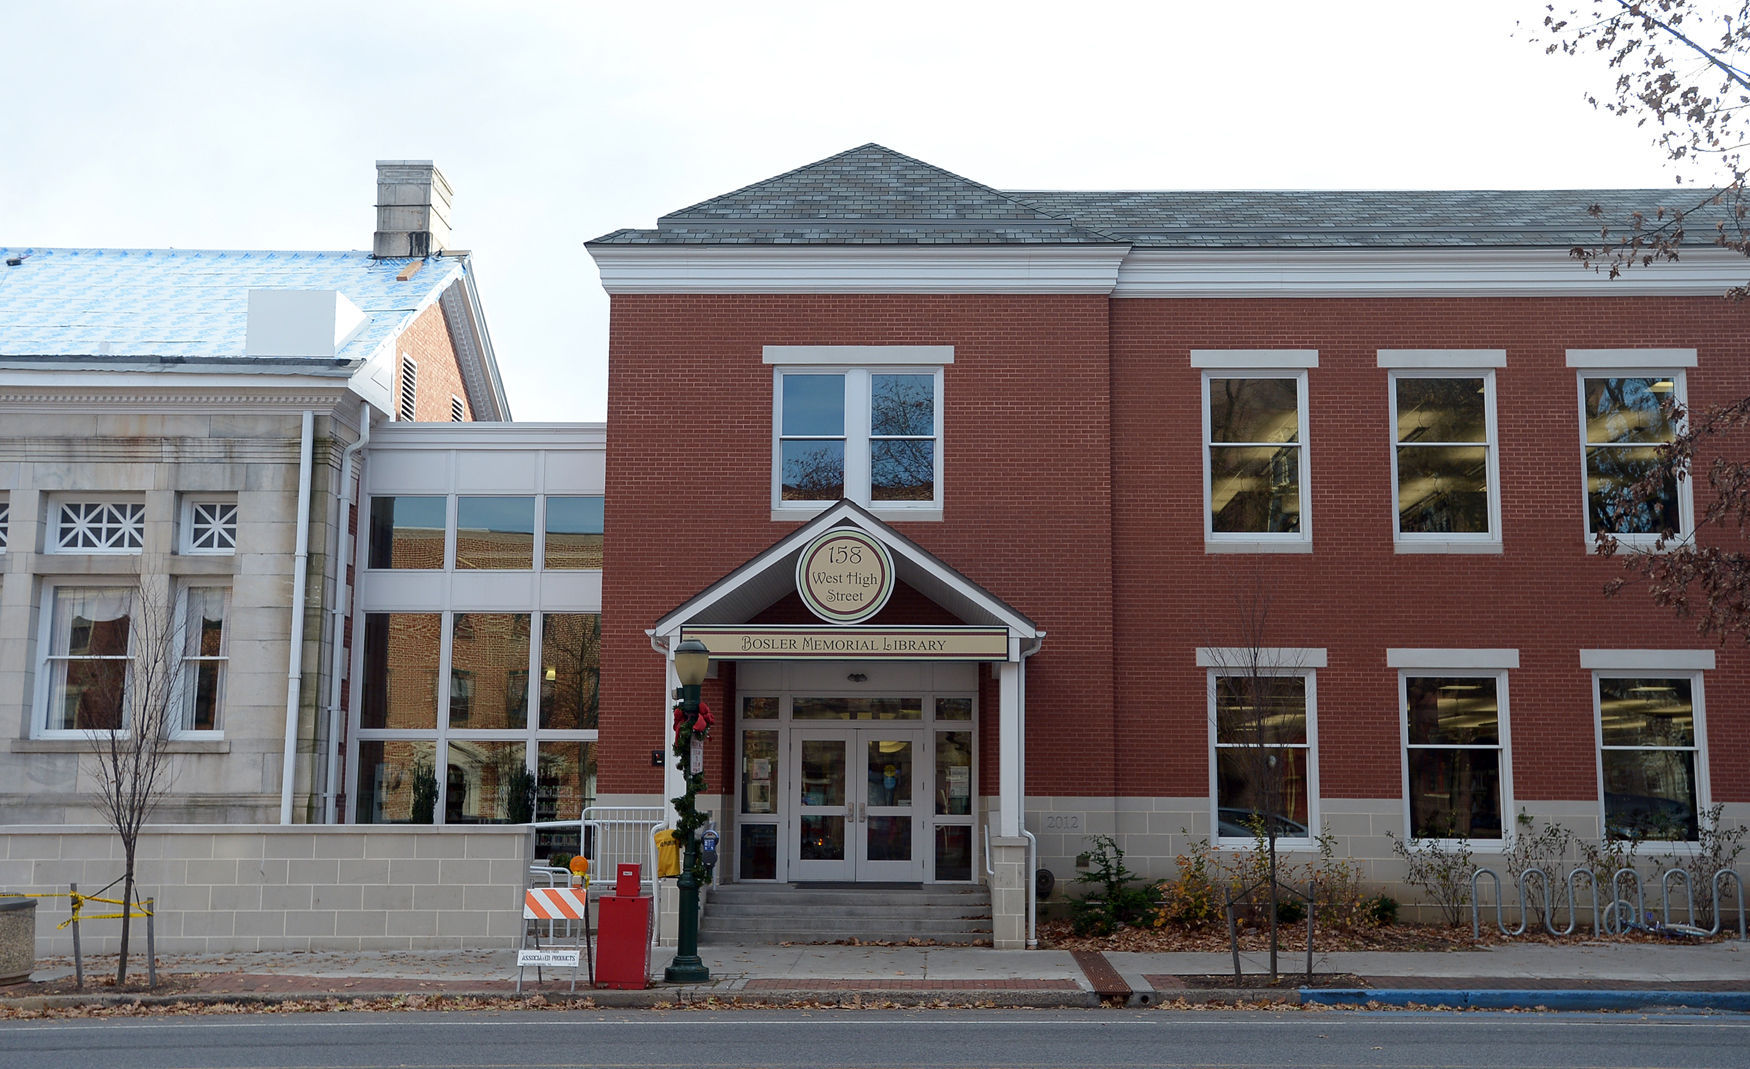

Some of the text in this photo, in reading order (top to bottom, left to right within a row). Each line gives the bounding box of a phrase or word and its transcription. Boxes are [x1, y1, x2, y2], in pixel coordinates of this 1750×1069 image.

[829, 546, 862, 564] 158
[812, 571, 878, 588] West High
[826, 589, 863, 603] Street
[741, 635, 947, 651] BOSLER MEMORIAL LIBRARY
[1047, 816, 1079, 829] 2012
